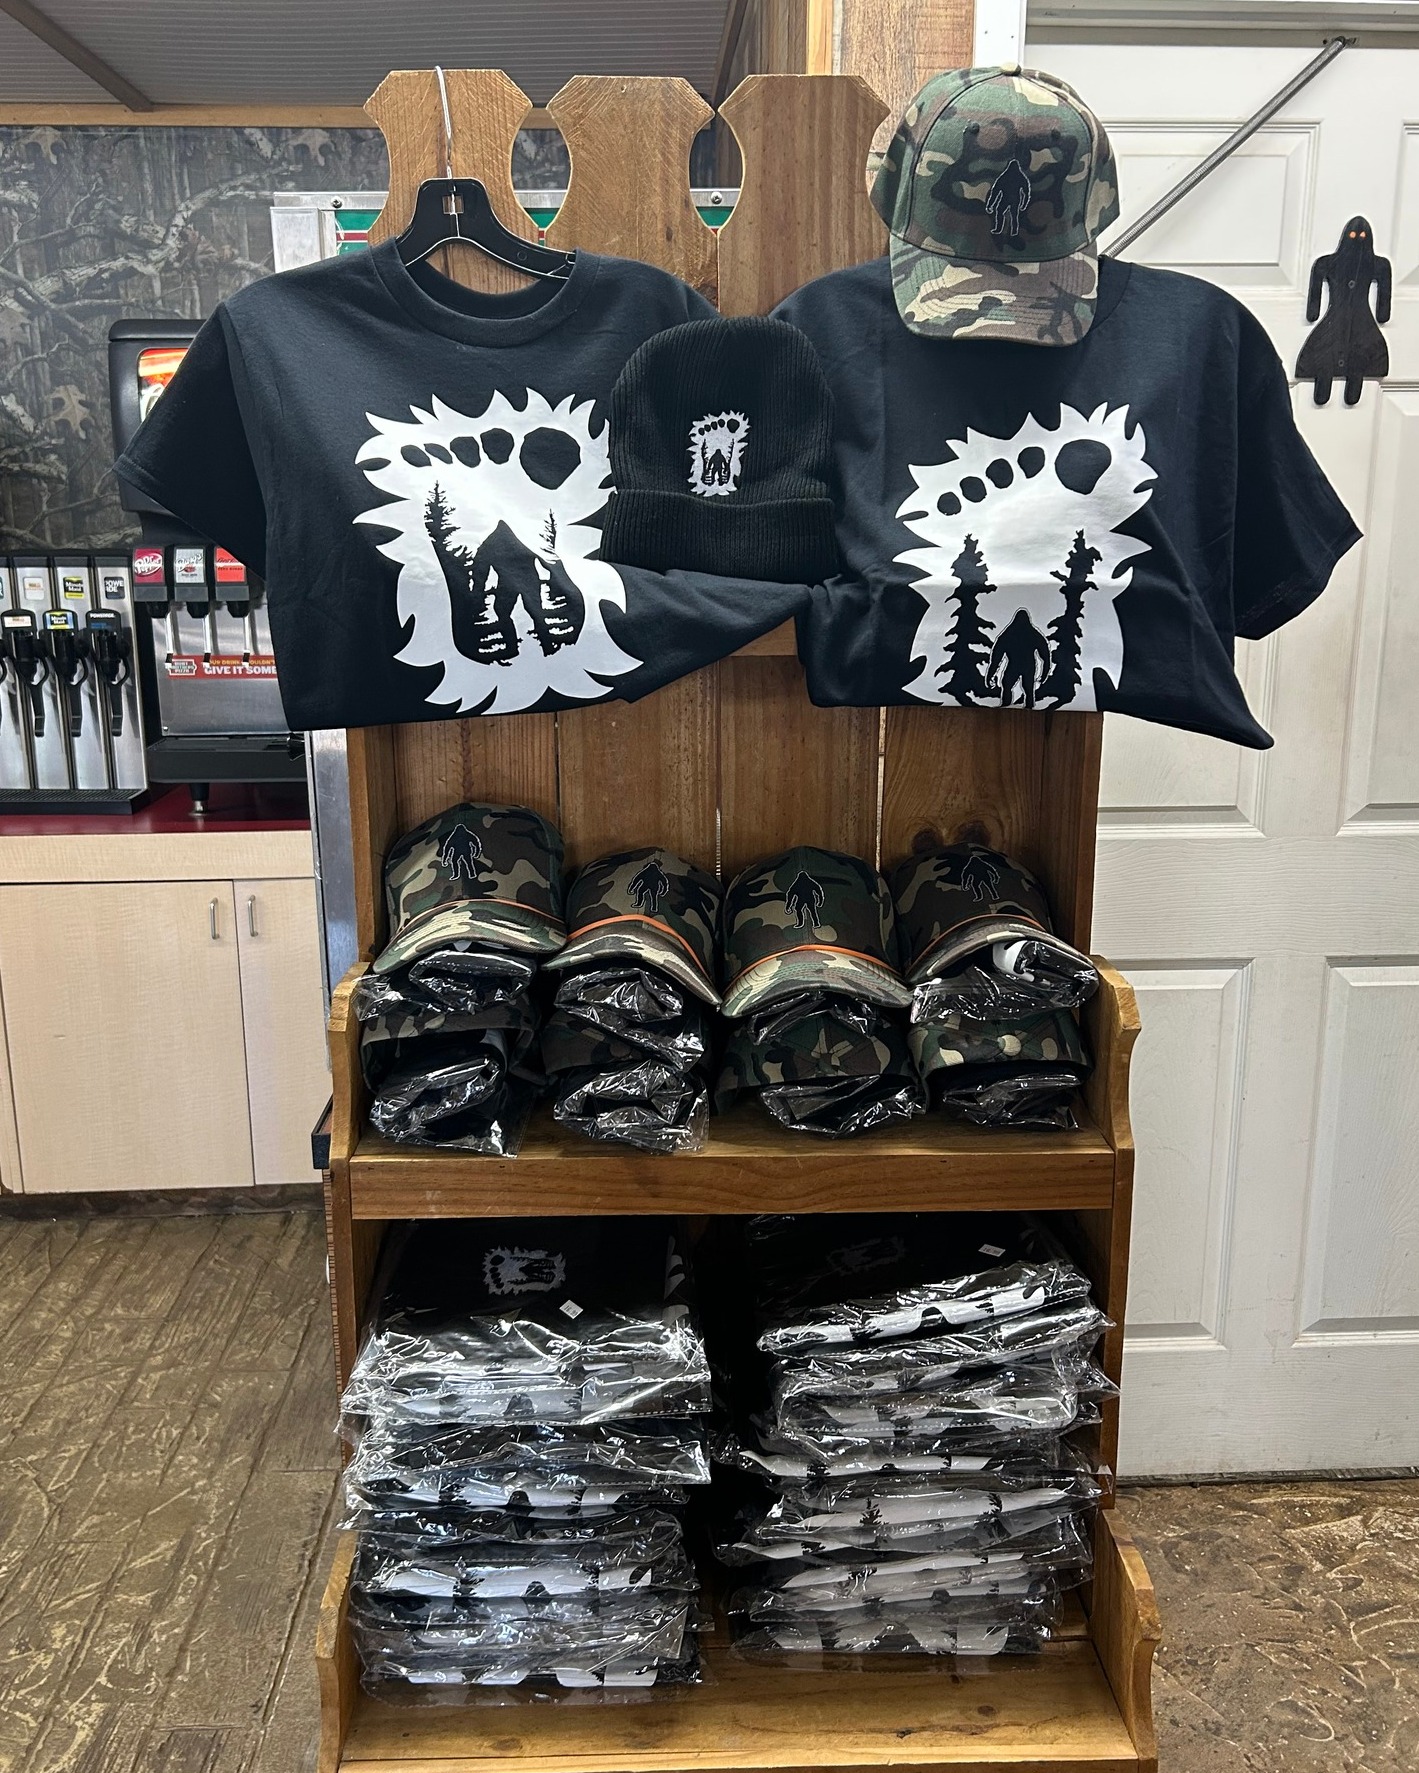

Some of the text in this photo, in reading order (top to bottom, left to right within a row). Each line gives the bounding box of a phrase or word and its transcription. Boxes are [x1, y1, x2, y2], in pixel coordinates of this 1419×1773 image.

[204, 665, 277, 675] GIVE IT SOME
